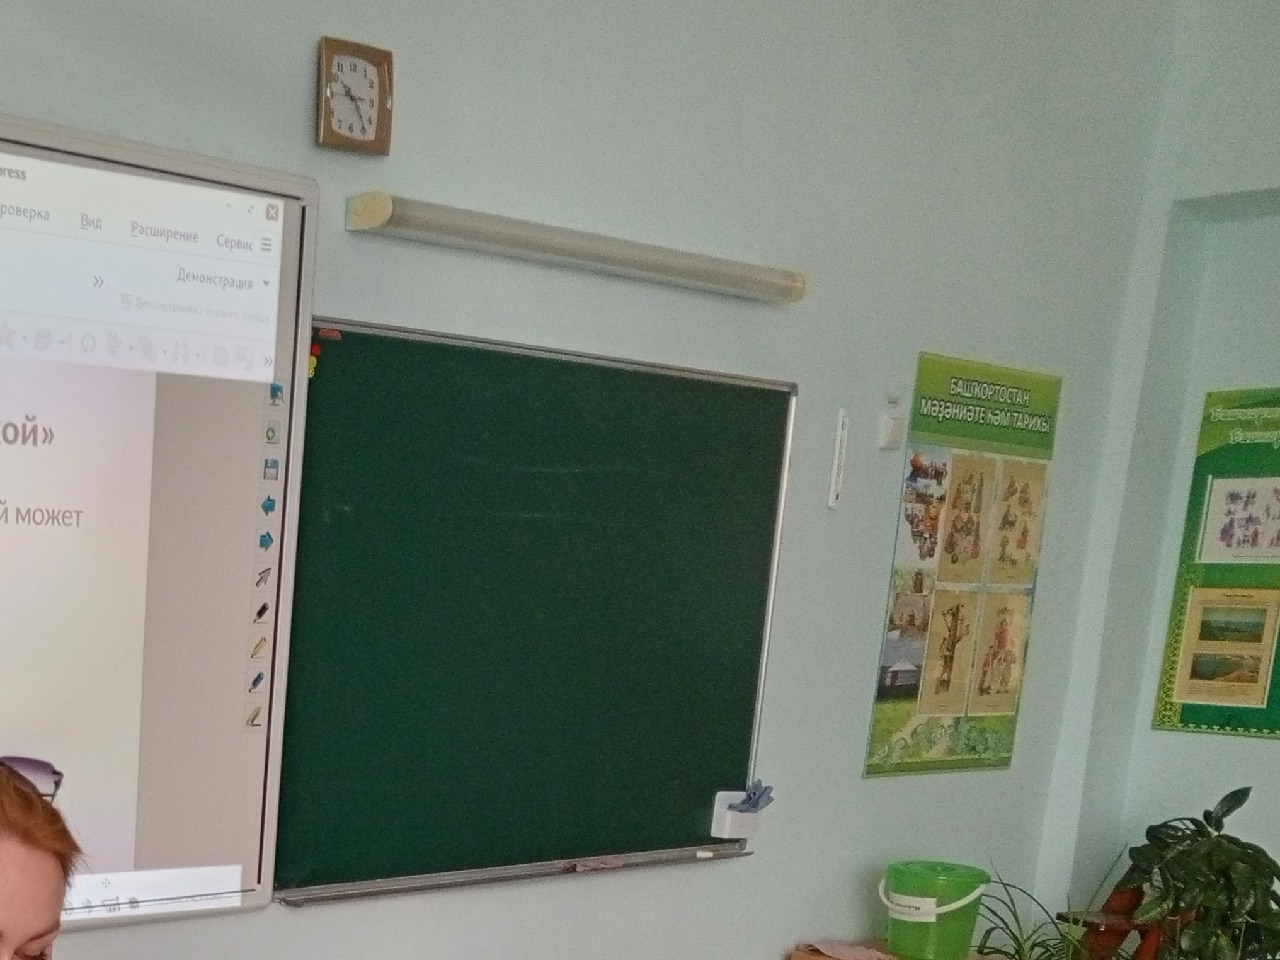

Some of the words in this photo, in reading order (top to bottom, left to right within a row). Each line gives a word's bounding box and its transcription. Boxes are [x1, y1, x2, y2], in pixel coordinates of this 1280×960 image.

[80, 212, 102, 230] Вид
[131, 220, 199, 244] Расширение
[216, 234, 254, 251] Сервис
[177, 267, 254, 290] Демонстрация
[950, 376, 1032, 408] БАШҠОРТОСТАН
[1012, 411, 1051, 434] ТАРИХЫ
[15, 506, 84, 528] может
